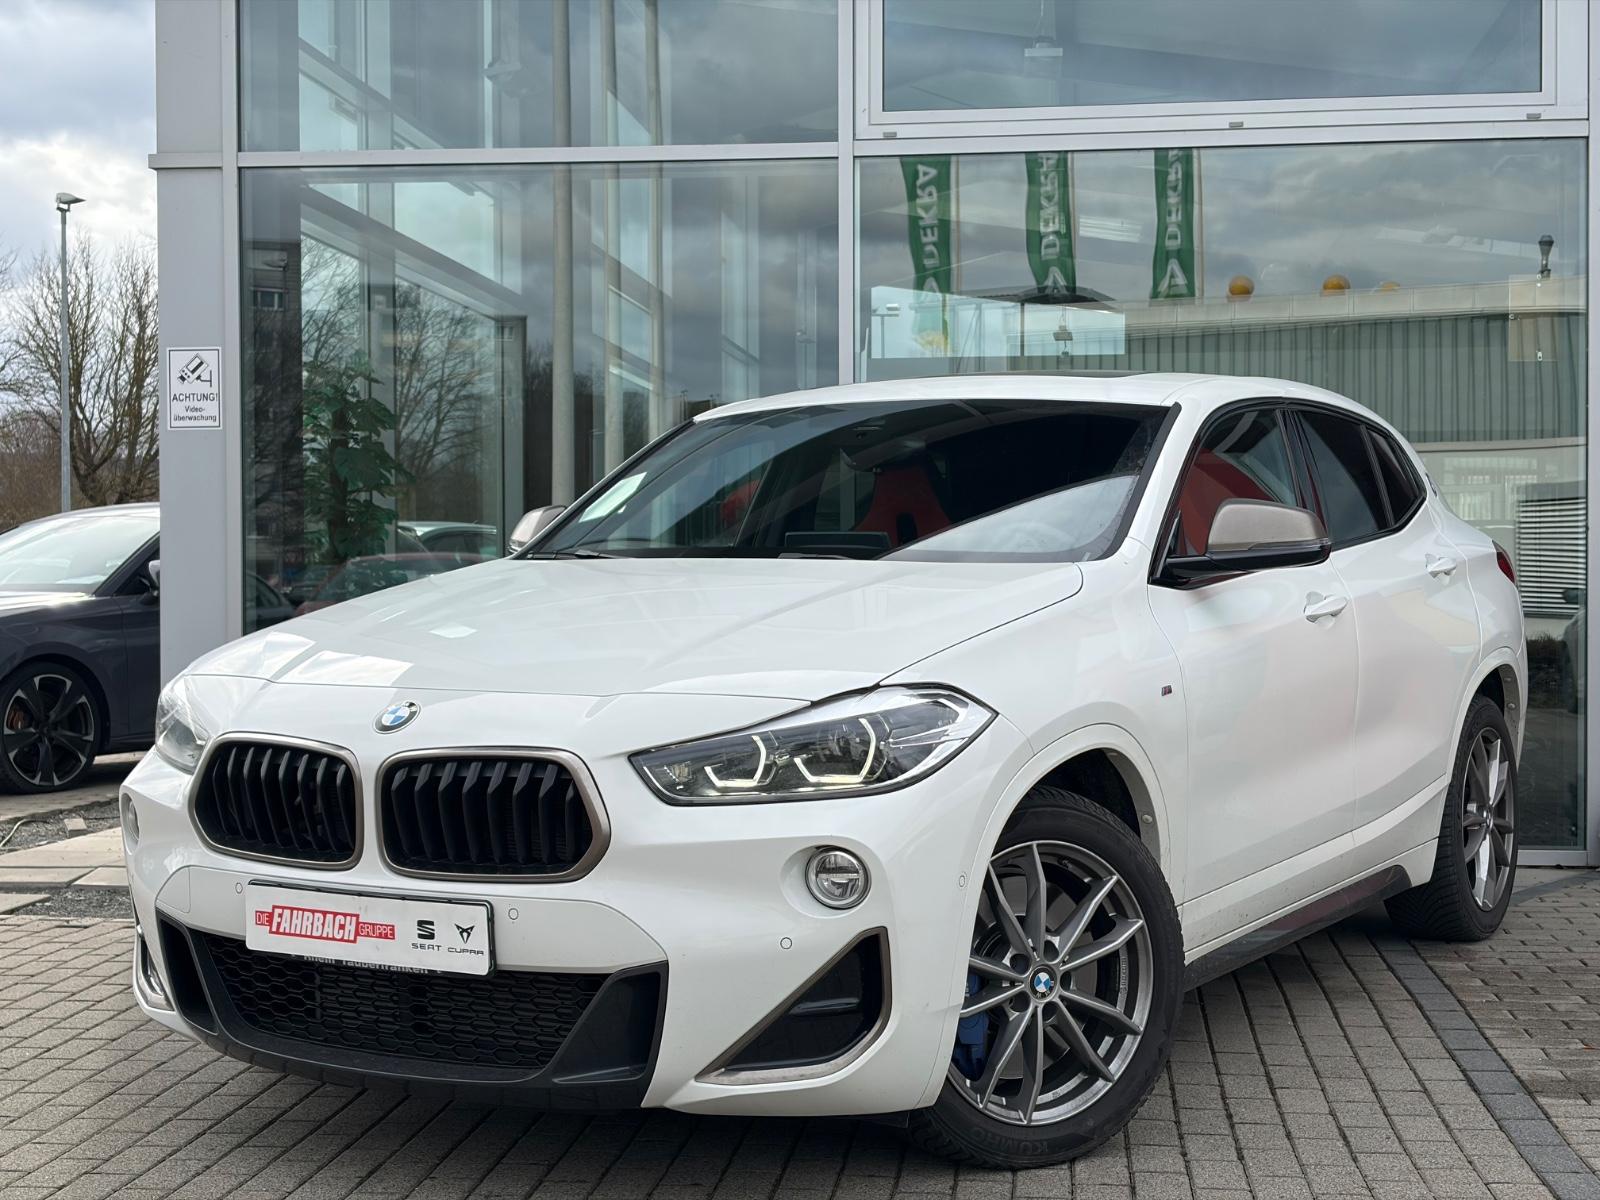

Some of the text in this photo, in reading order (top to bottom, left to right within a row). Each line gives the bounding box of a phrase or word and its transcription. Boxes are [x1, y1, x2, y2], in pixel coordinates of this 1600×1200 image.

[172, 393, 218, 402] ACHTUNG!
[174, 414, 217, 422] überwachung
[256, 908, 394, 941] DIE FAHRBACH GRUPPE
[411, 943, 442, 951] SEAT
[447, 947, 485, 956] CUPRA
